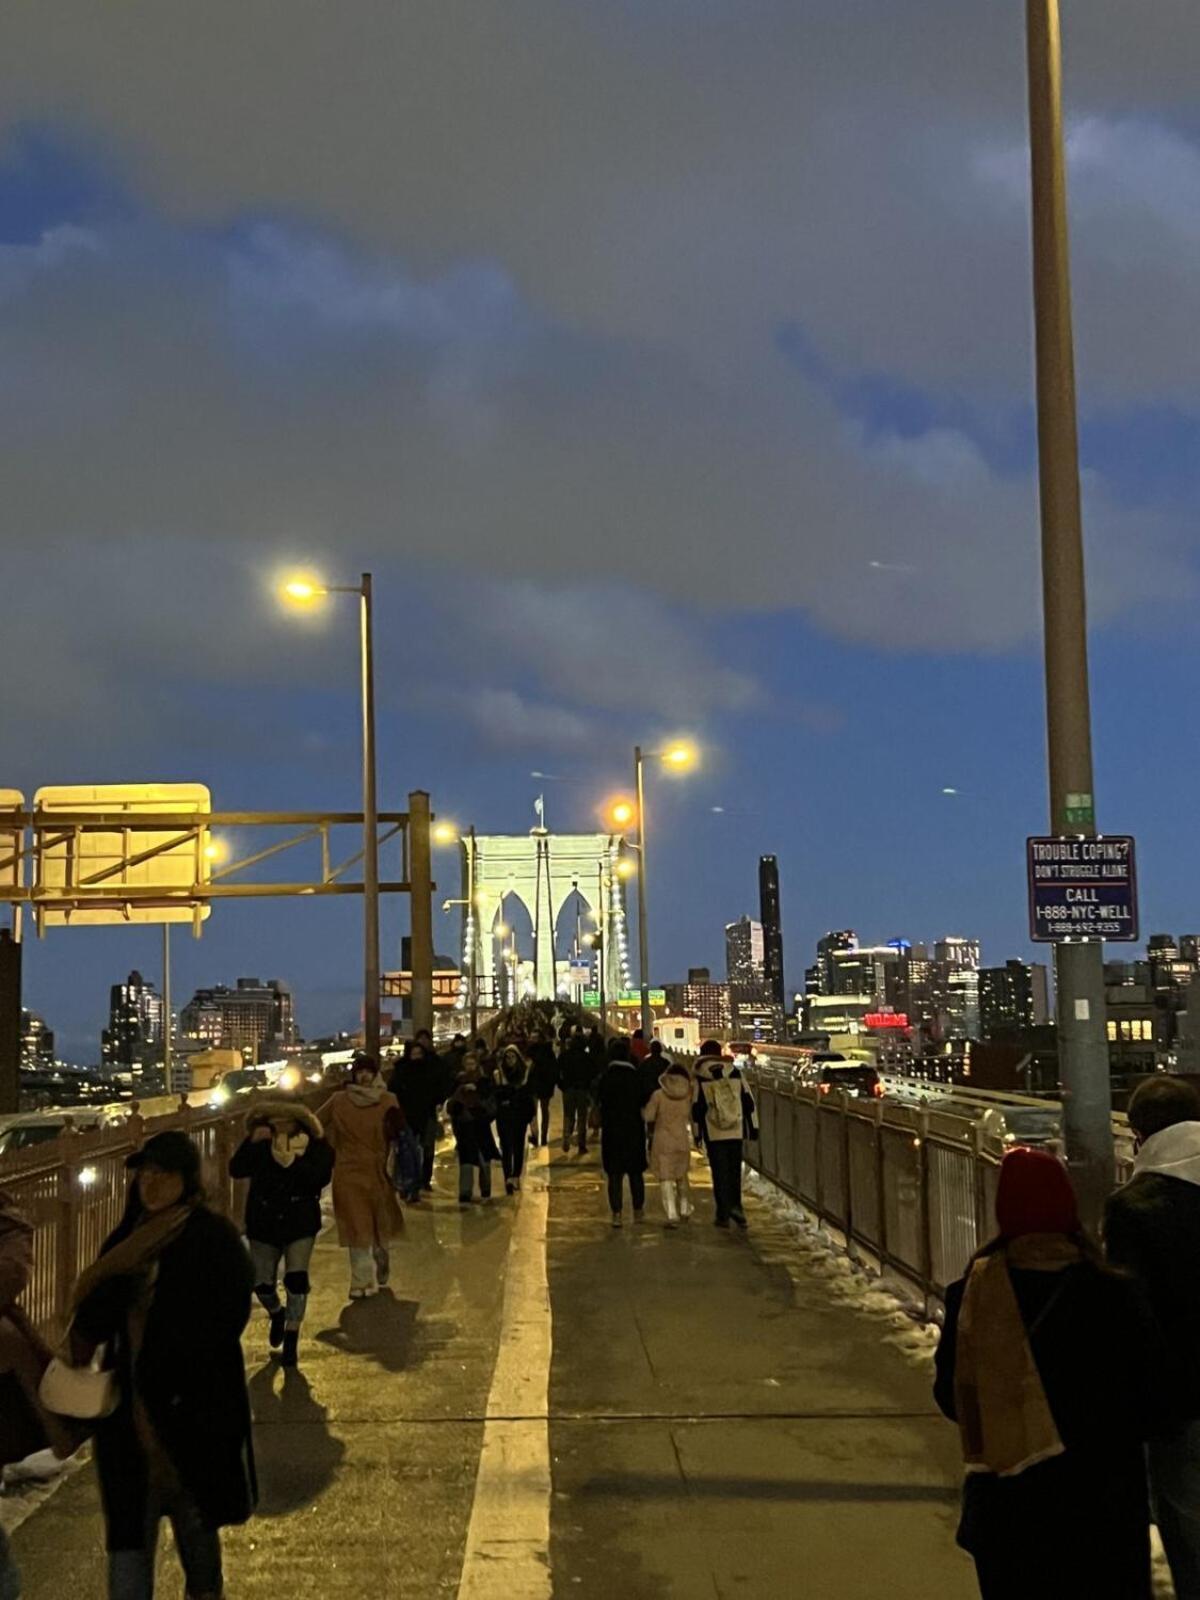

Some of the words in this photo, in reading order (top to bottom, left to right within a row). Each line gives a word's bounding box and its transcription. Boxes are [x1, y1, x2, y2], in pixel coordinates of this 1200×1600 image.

[1033, 844, 1080, 860] TROUBLE
[1082, 843, 1129, 860] COPING?
[1035, 865, 1059, 878] DON'T
[1102, 864, 1128, 878] ALONE
[1066, 888, 1100, 902] CALL
[1036, 905, 1131, 919] 1-888-NYC-WELL
